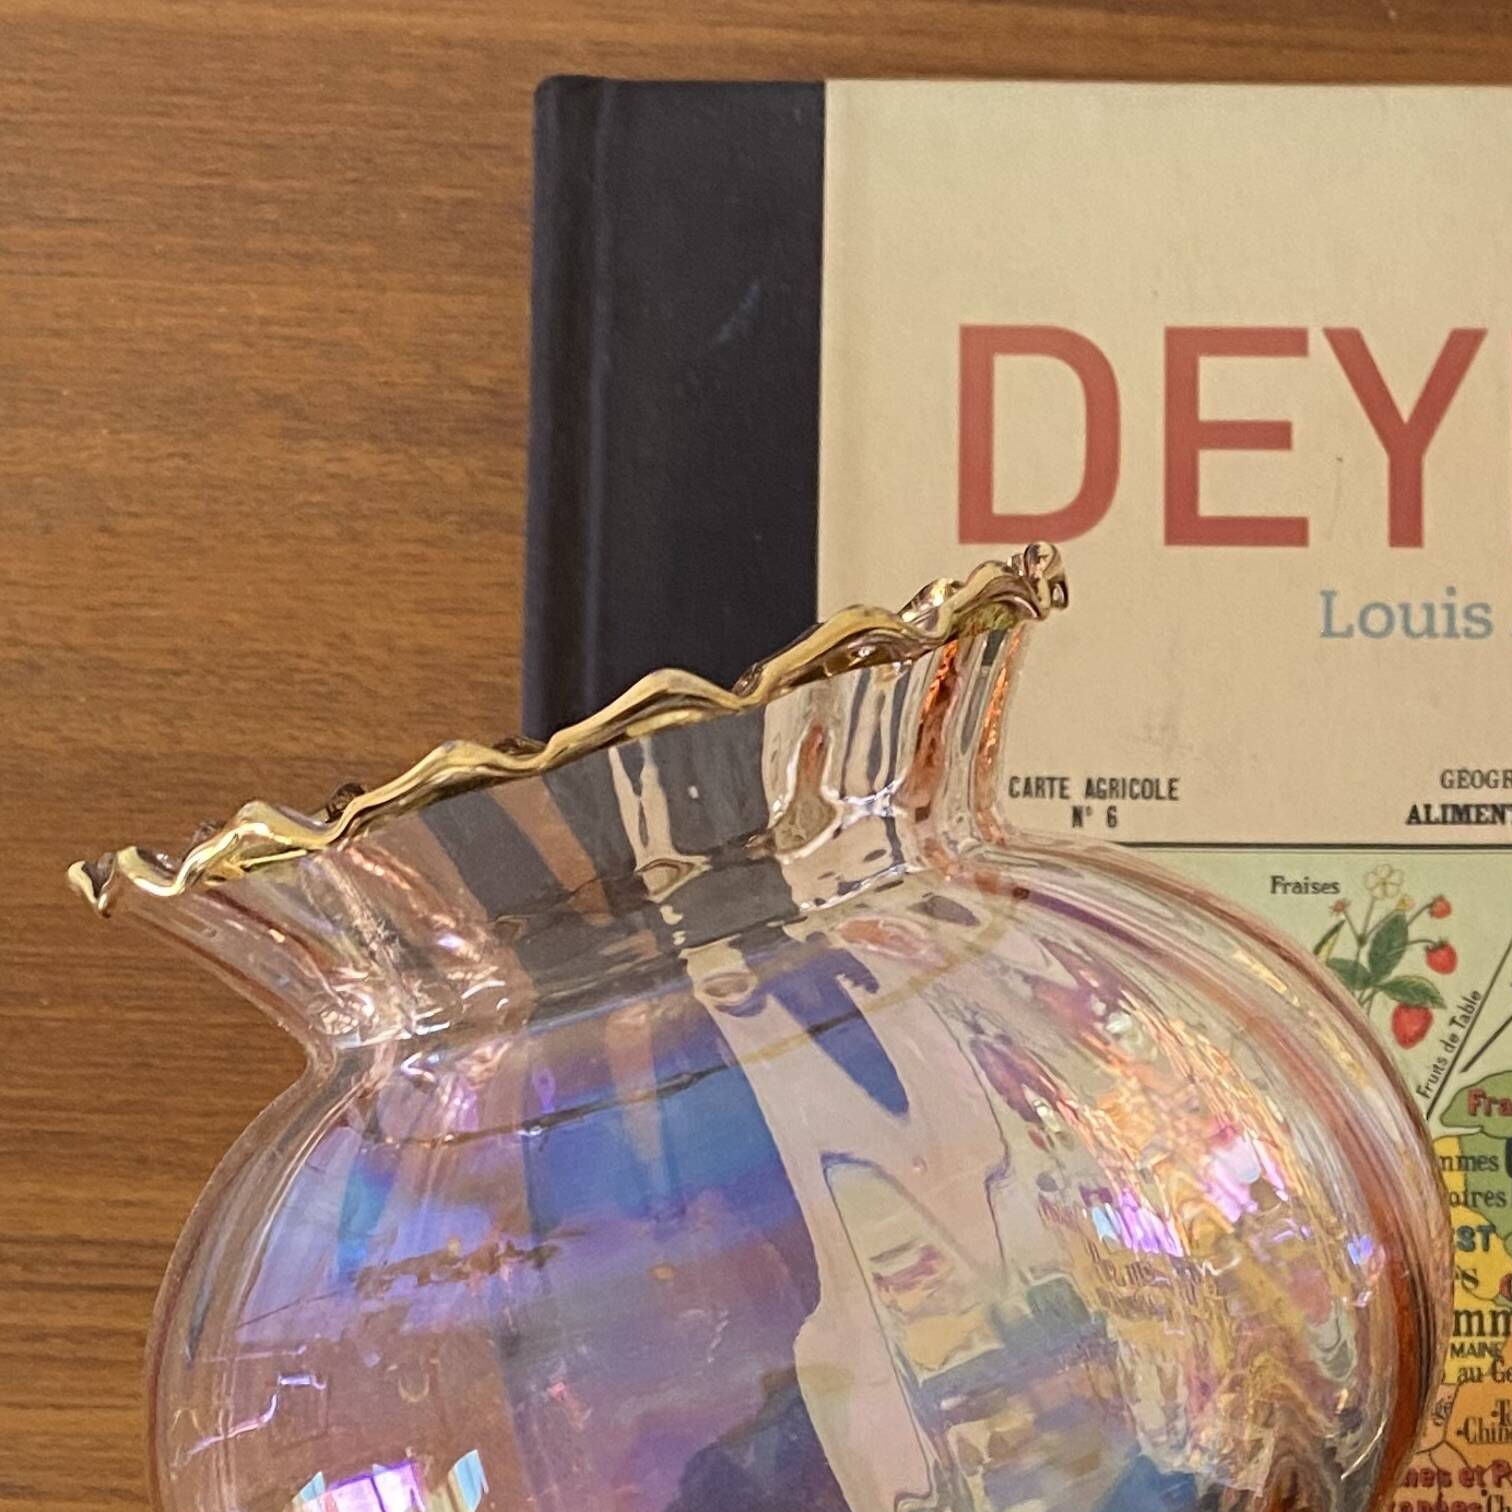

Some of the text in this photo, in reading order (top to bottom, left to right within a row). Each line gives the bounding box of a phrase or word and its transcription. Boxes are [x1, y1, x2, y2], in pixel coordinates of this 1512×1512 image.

[1319, 586, 1494, 641] Louis
[1008, 776, 1180, 801] CARTE AGRICOLE
[1105, 805, 1118, 829] 6
[1270, 875, 1341, 895] Fraises
[1416, 990, 1483, 1100] Fruits de Table
